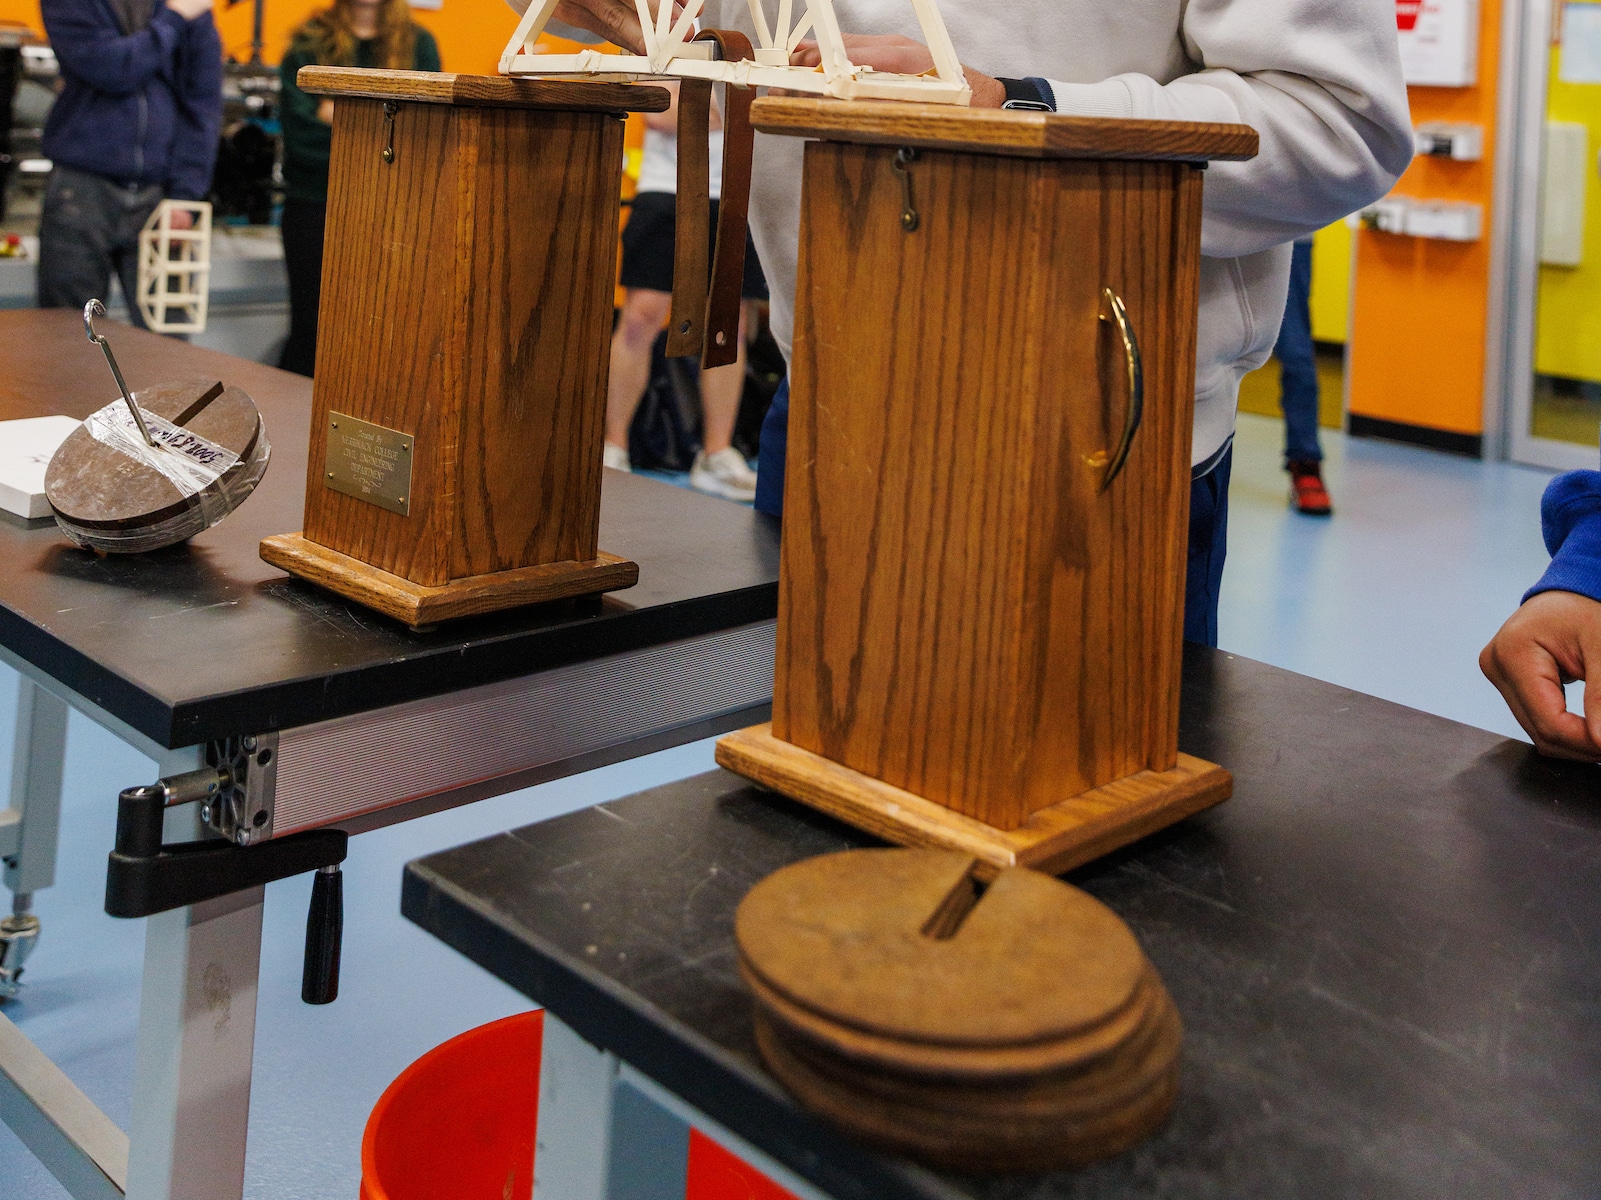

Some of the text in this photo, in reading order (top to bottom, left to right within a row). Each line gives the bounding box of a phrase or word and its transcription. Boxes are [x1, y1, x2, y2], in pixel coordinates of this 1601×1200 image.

[343, 447, 395, 472] CIVIL ENGINEERING
[374, 445, 399, 461] COLLEGE
[350, 462, 385, 482] DEPARTMENT
